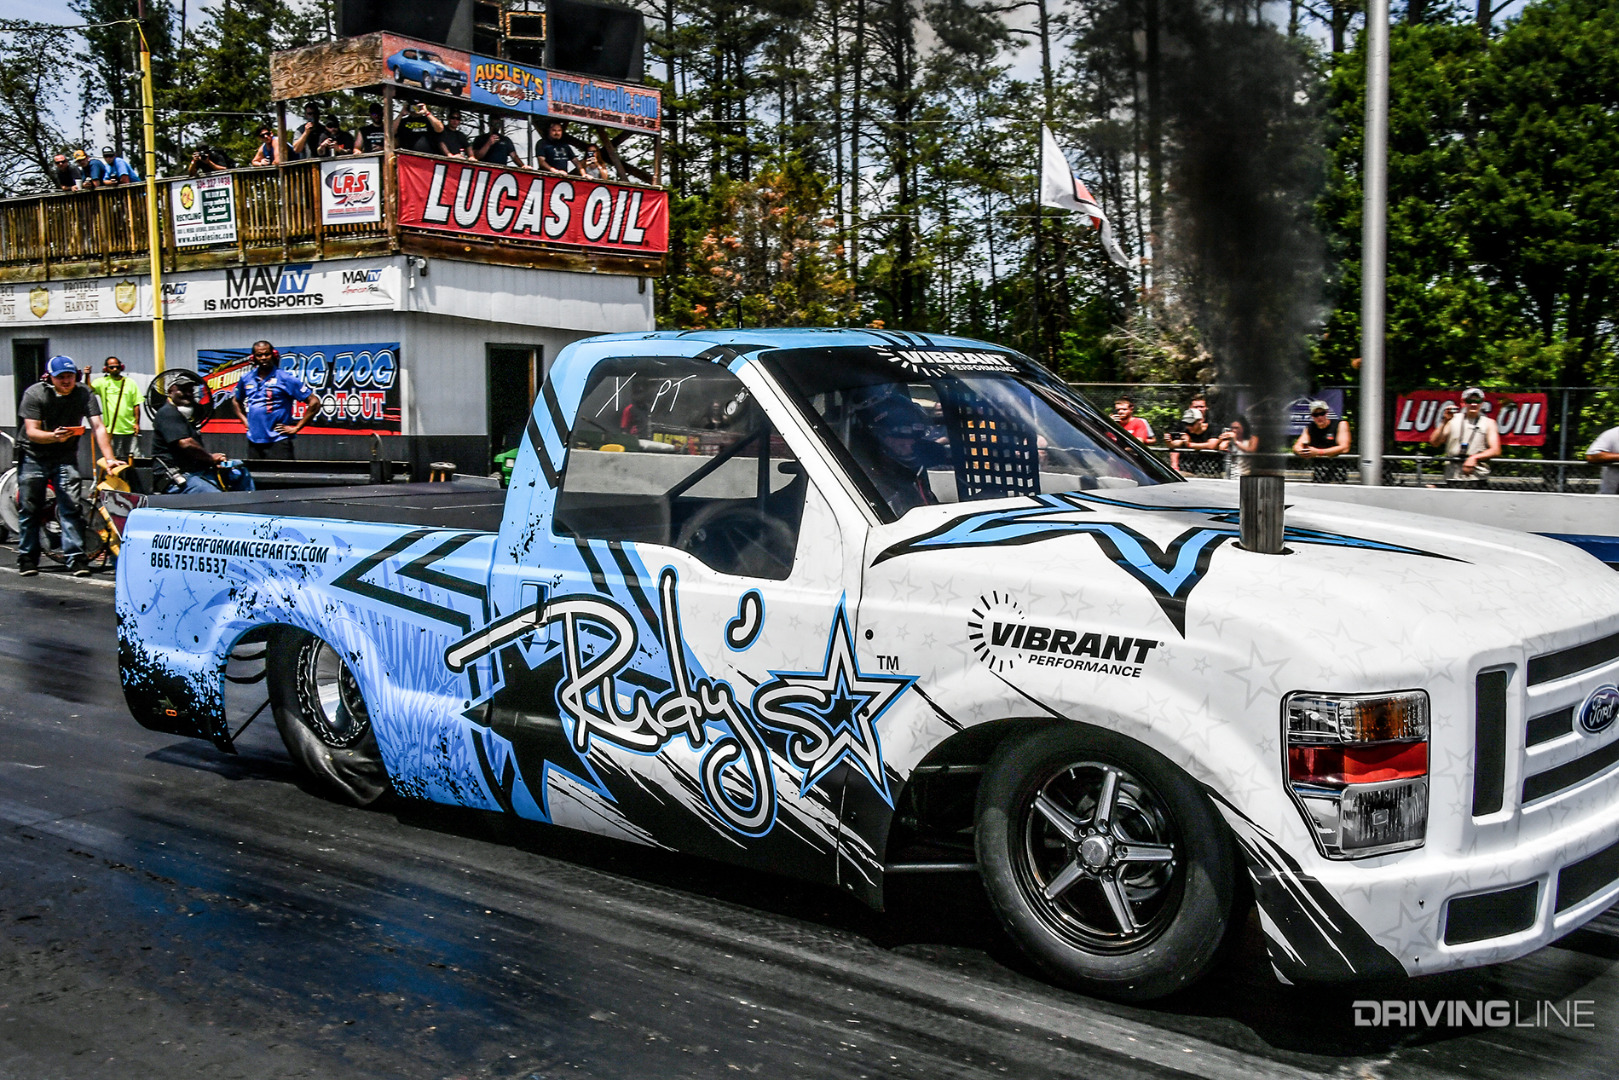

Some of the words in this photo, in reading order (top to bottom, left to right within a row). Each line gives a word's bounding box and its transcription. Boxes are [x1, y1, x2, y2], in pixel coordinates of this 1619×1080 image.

[474, 63, 546, 96] AUSLEY'S
[550, 78, 658, 119] www.chevelle.com
[332, 171, 370, 197] LRS
[422, 162, 577, 240] LUCAS
[582, 185, 646, 246] OIL
[63, 280, 99, 293] PROTECT
[225, 263, 315, 298] MAVTV
[341, 268, 383, 285] MAVTV
[64, 300, 99, 313] HARVEST
[203, 299, 217, 311] IS
[219, 293, 324, 310] MOTORSPORTS
[333, 350, 398, 389] DOG
[897, 350, 1012, 367] VIBRANT
[949, 364, 1021, 374] PERFORMANCE
[595, 372, 637, 418] X
[651, 374, 698, 413] PT
[152, 534, 329, 563] RUDYSPERFORMANCEPARTS.COM
[150, 552, 227, 574] 866.757.6537
[1027, 654, 1143, 679] PERFORMANCE
[1588, 692, 1615, 727] Ford
